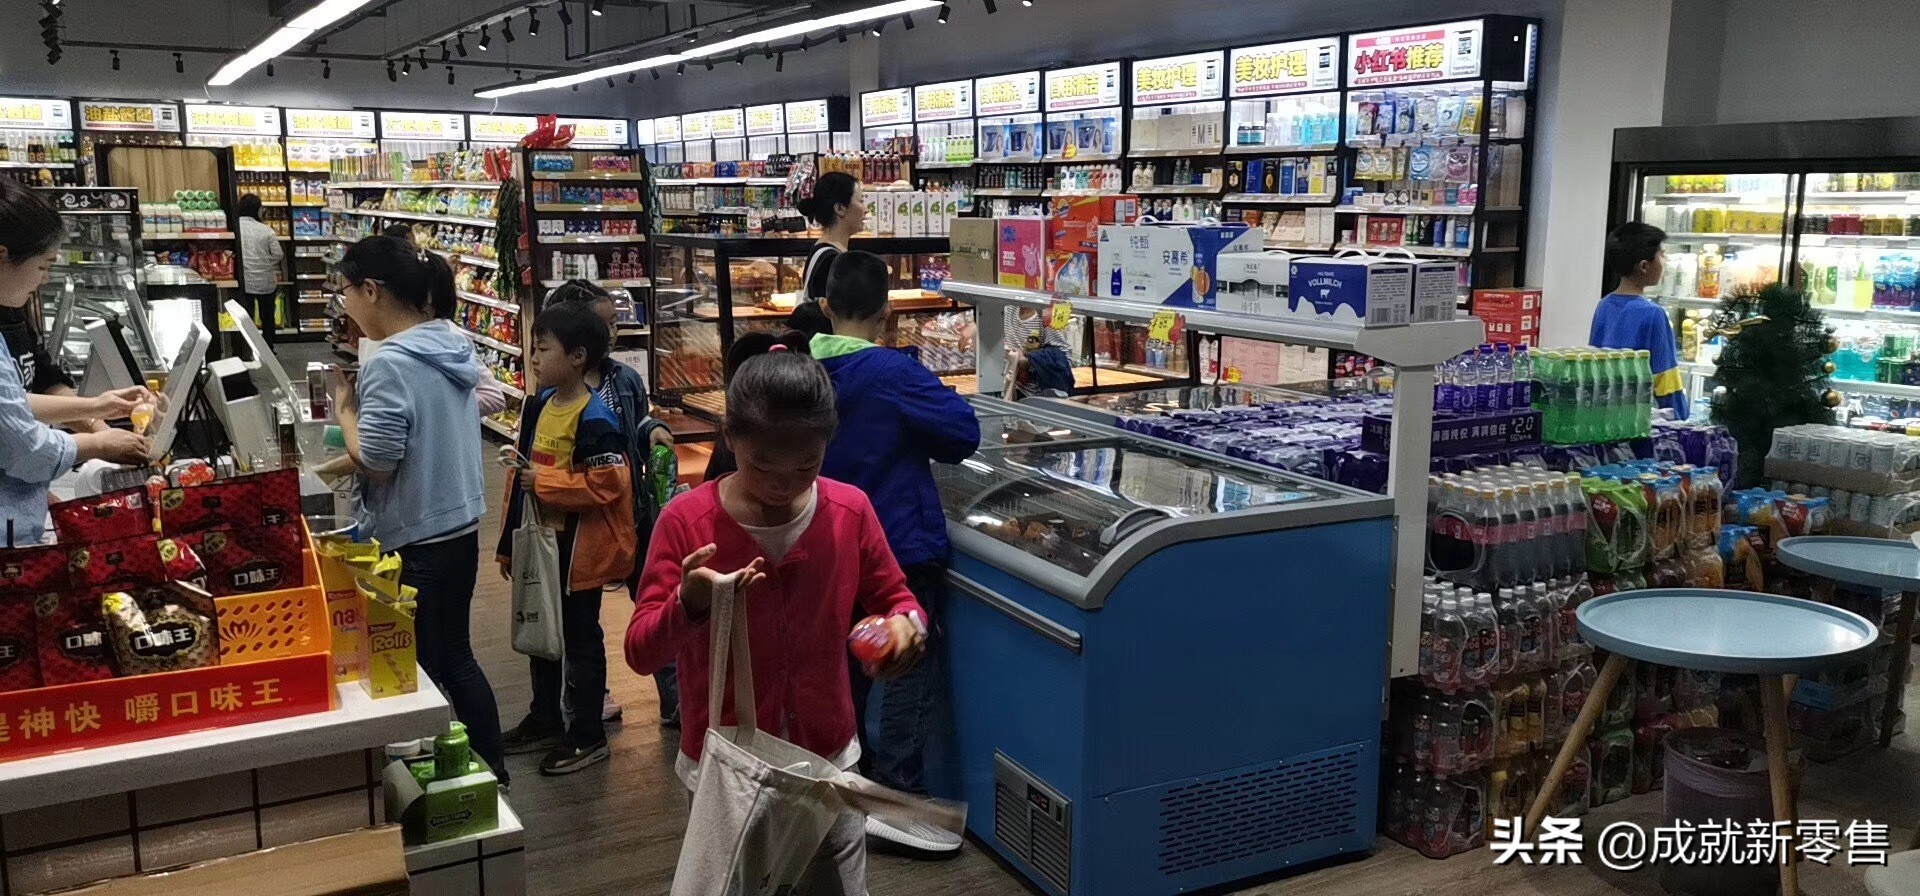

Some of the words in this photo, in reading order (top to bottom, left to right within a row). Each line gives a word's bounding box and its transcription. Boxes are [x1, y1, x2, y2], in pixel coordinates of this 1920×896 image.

[1236, 49, 1307, 83] 美妆护理
[1355, 43, 1444, 74] 小红书推荐
[1050, 71, 1099, 99] 日用清洁
[1138, 63, 1197, 91] 美妆护理
[85, 105, 153, 123] 油盐酱醋
[1162, 249, 1189, 265] 安慕希
[1308, 277, 1343, 289] VOLLMILCH
[233, 567, 280, 586] 口味王
[134, 627, 193, 651] 口味王
[125, 678, 283, 724] 嚼口味王
